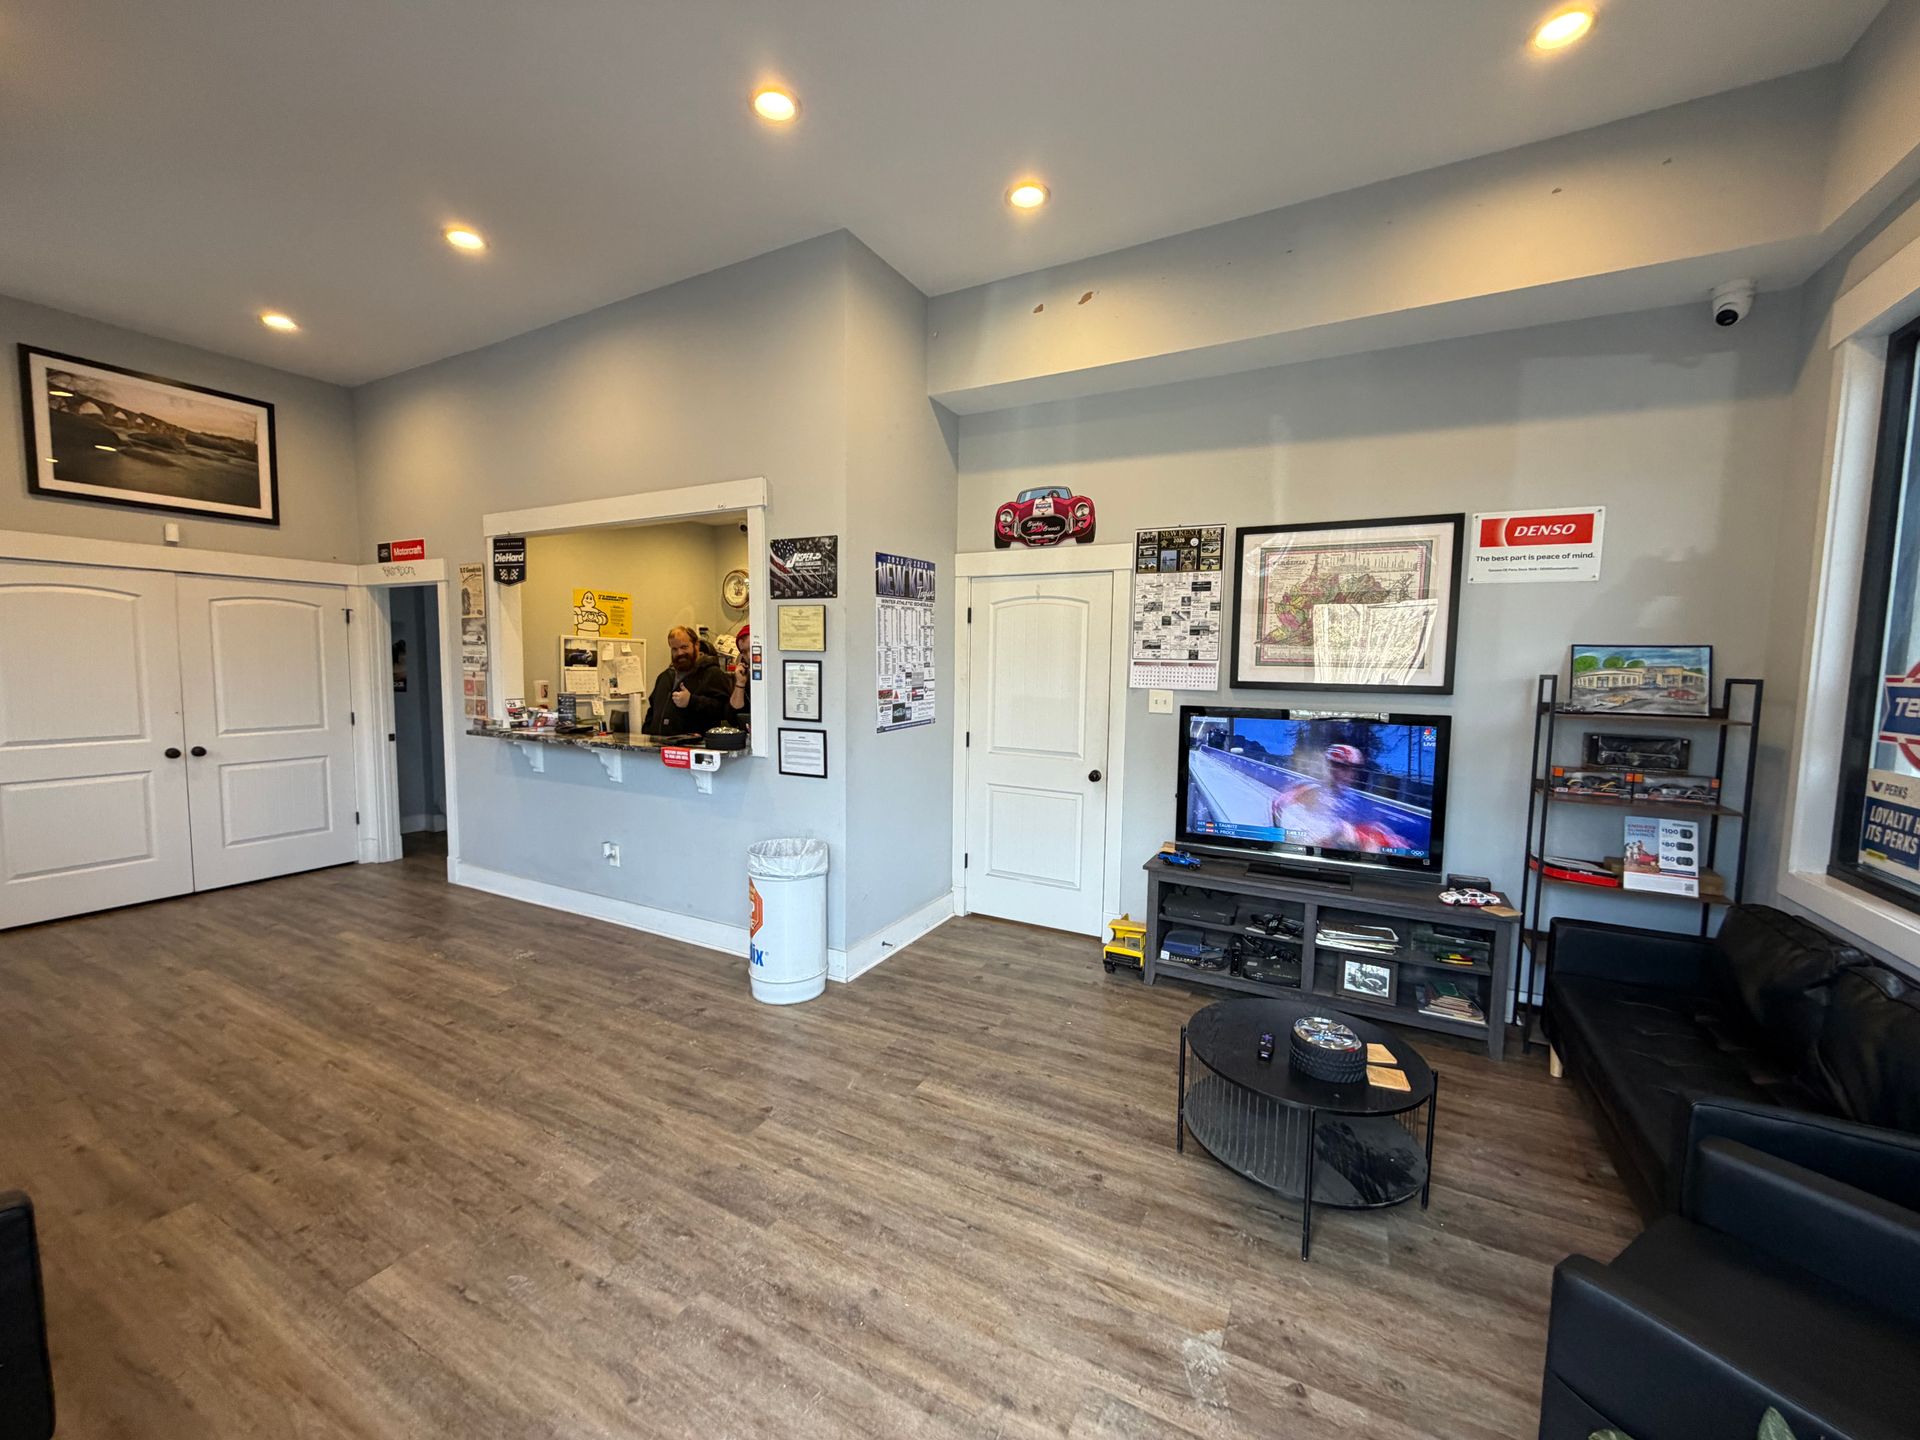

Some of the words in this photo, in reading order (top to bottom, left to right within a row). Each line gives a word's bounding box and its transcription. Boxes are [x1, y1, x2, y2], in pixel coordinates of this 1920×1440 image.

[1513, 523, 1576, 537] DENSO
[393, 545, 423, 556] Motorcraft
[494, 552, 524, 562] DieHard
[887, 556, 904, 565] 2025
[877, 561, 906, 596] NEW
[909, 566, 935, 598] KENT
[1884, 783, 1908, 800] PERKS
[1869, 805, 1914, 832] LOYALTY
[1865, 823, 1883, 843] ITS
[1882, 829, 1919, 855] PERKS
